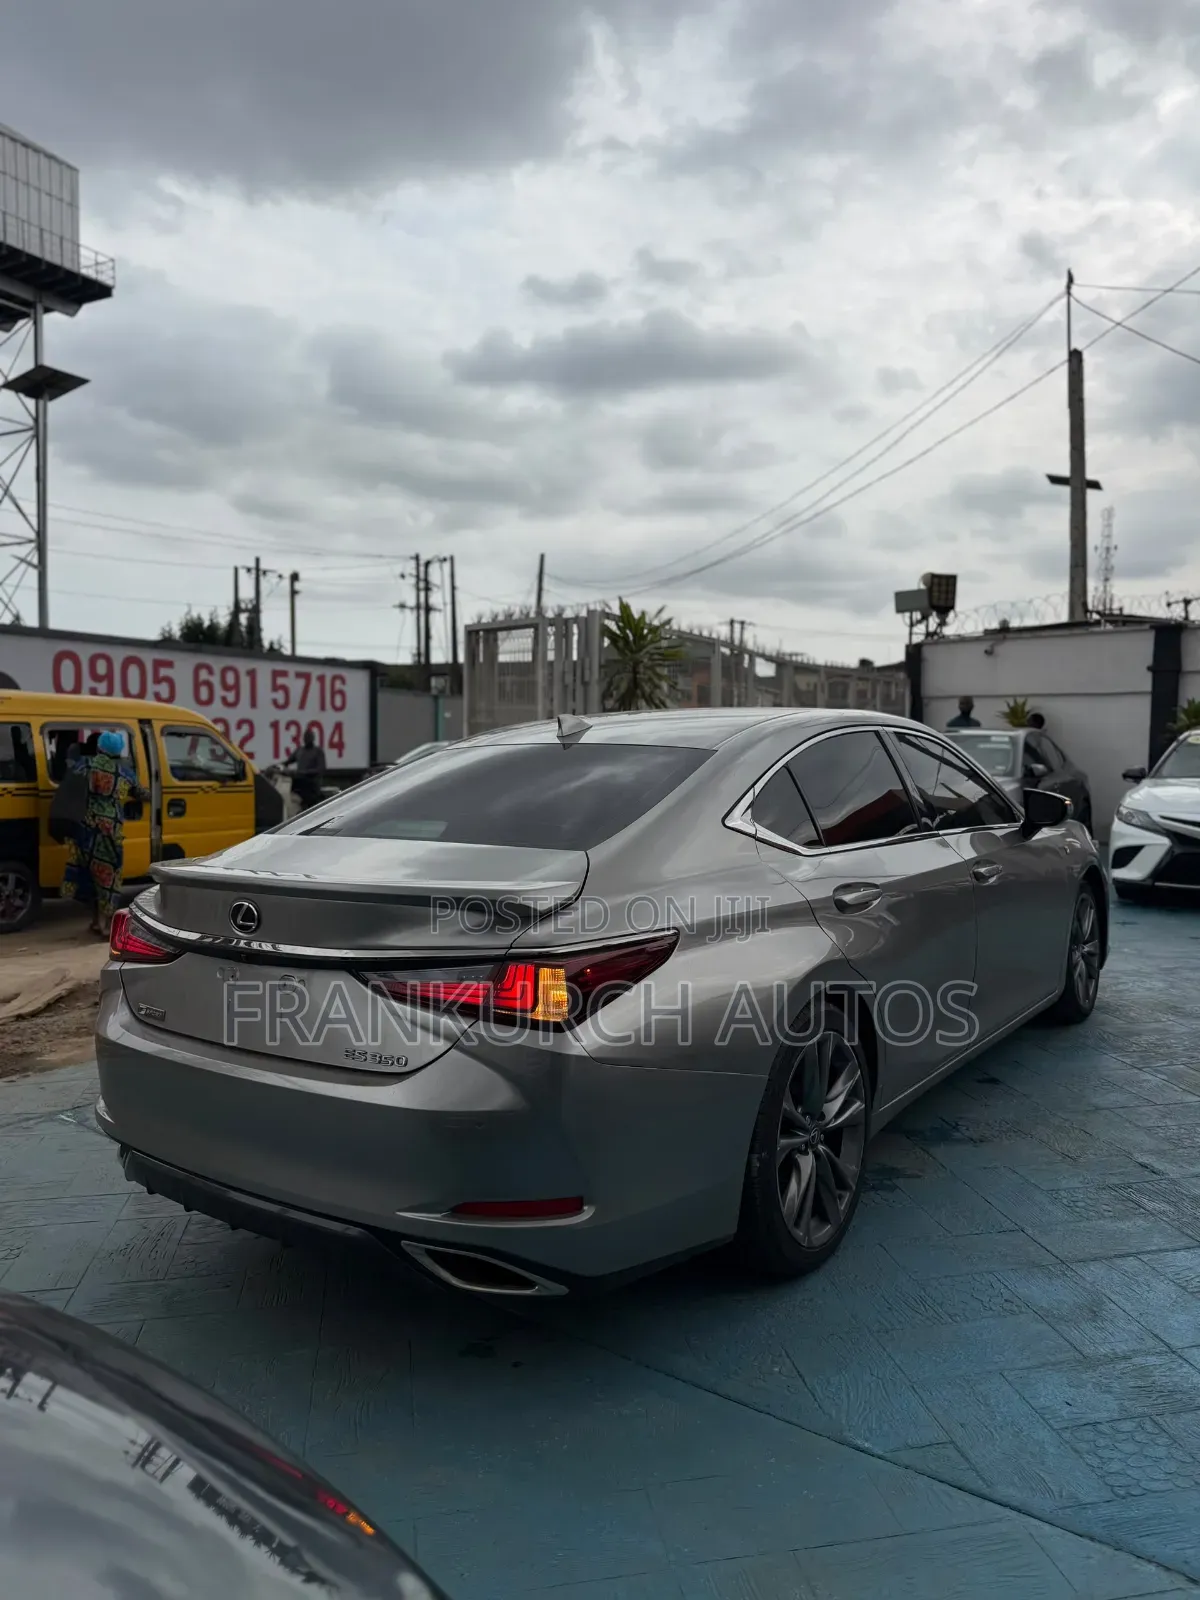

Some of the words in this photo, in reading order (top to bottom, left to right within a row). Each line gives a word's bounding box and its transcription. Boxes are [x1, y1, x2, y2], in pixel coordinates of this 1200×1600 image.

[52, 649, 176, 705] 0905
[193, 662, 258, 710] 691
[271, 668, 347, 712] 5716
[369, 1051, 408, 1067] 350
